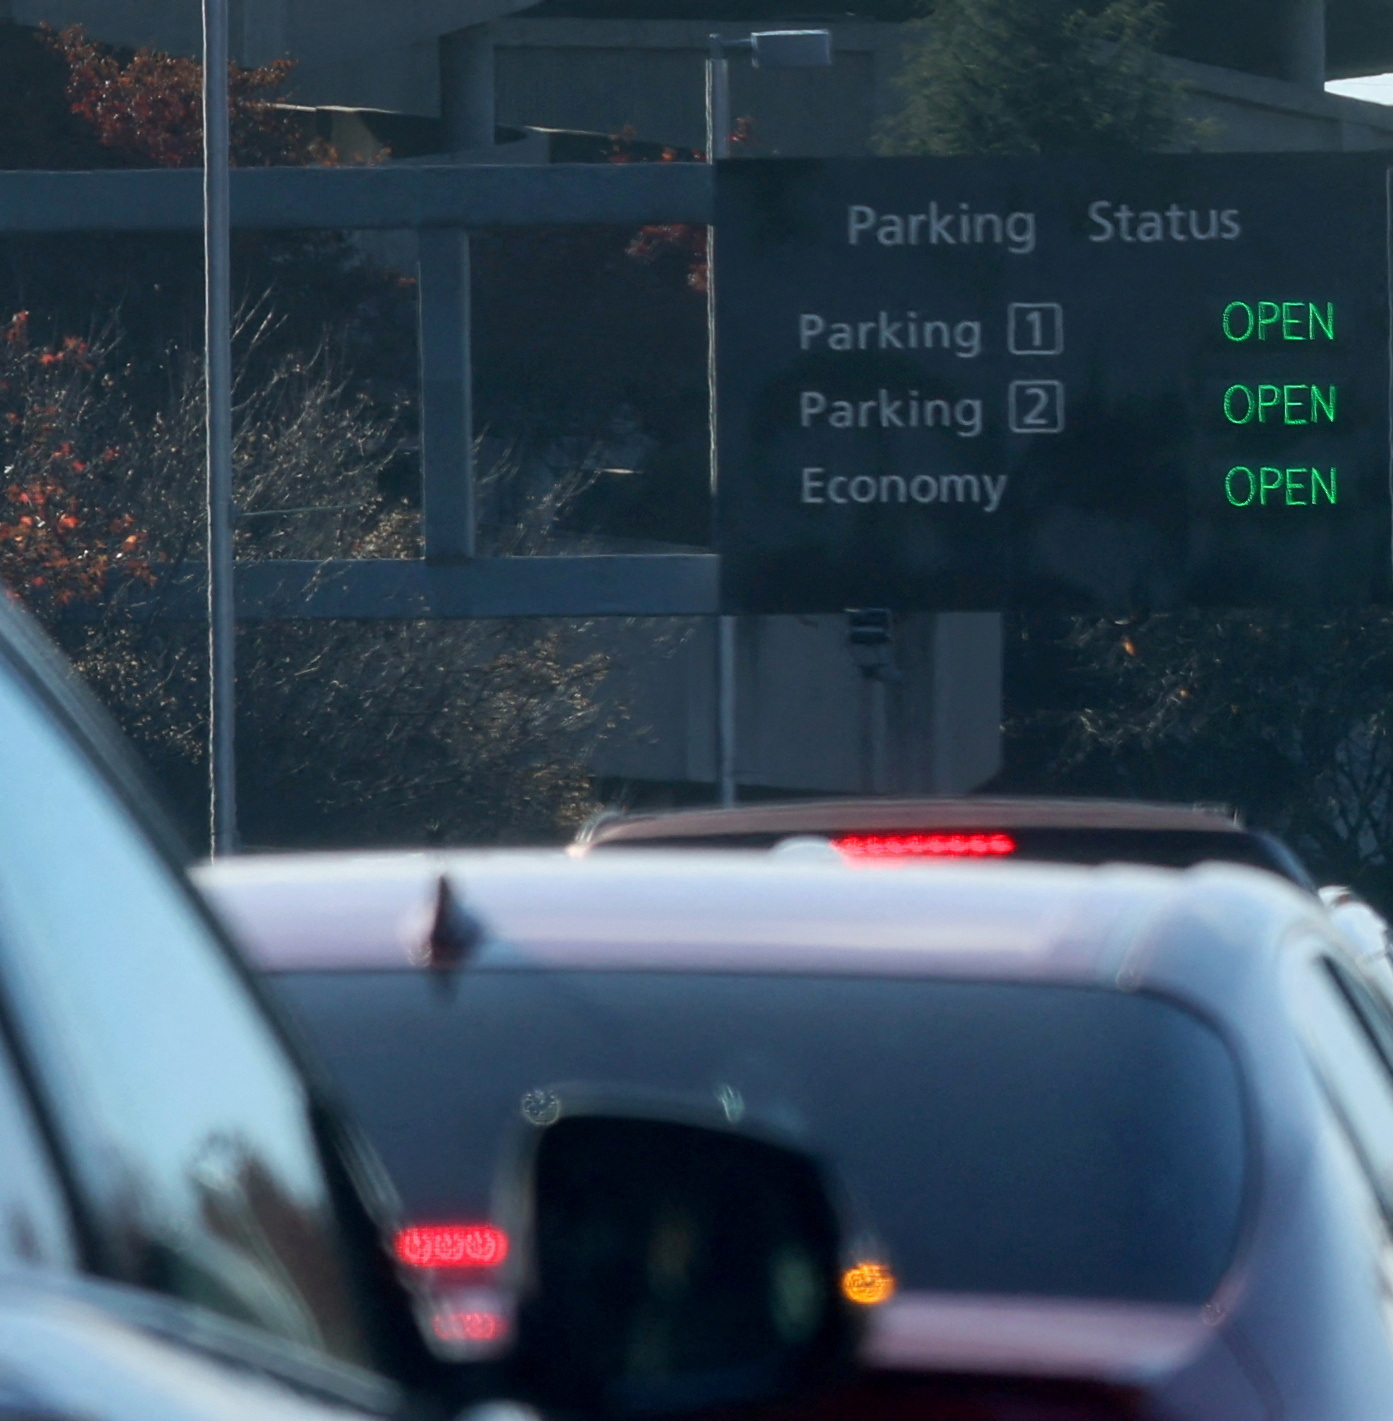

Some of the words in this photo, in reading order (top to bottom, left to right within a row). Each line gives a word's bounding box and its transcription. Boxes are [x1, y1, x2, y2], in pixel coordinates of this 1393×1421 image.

[848, 201, 1036, 255] Parking
[1089, 200, 1241, 243] Status
[799, 310, 982, 359] Parking
[1222, 300, 1335, 342] OPEN
[800, 388, 983, 438] Parking
[1022, 388, 1050, 427] 2
[1223, 383, 1336, 425] OPEN
[801, 466, 1007, 513] Economy
[1224, 465, 1337, 507] OPEN
